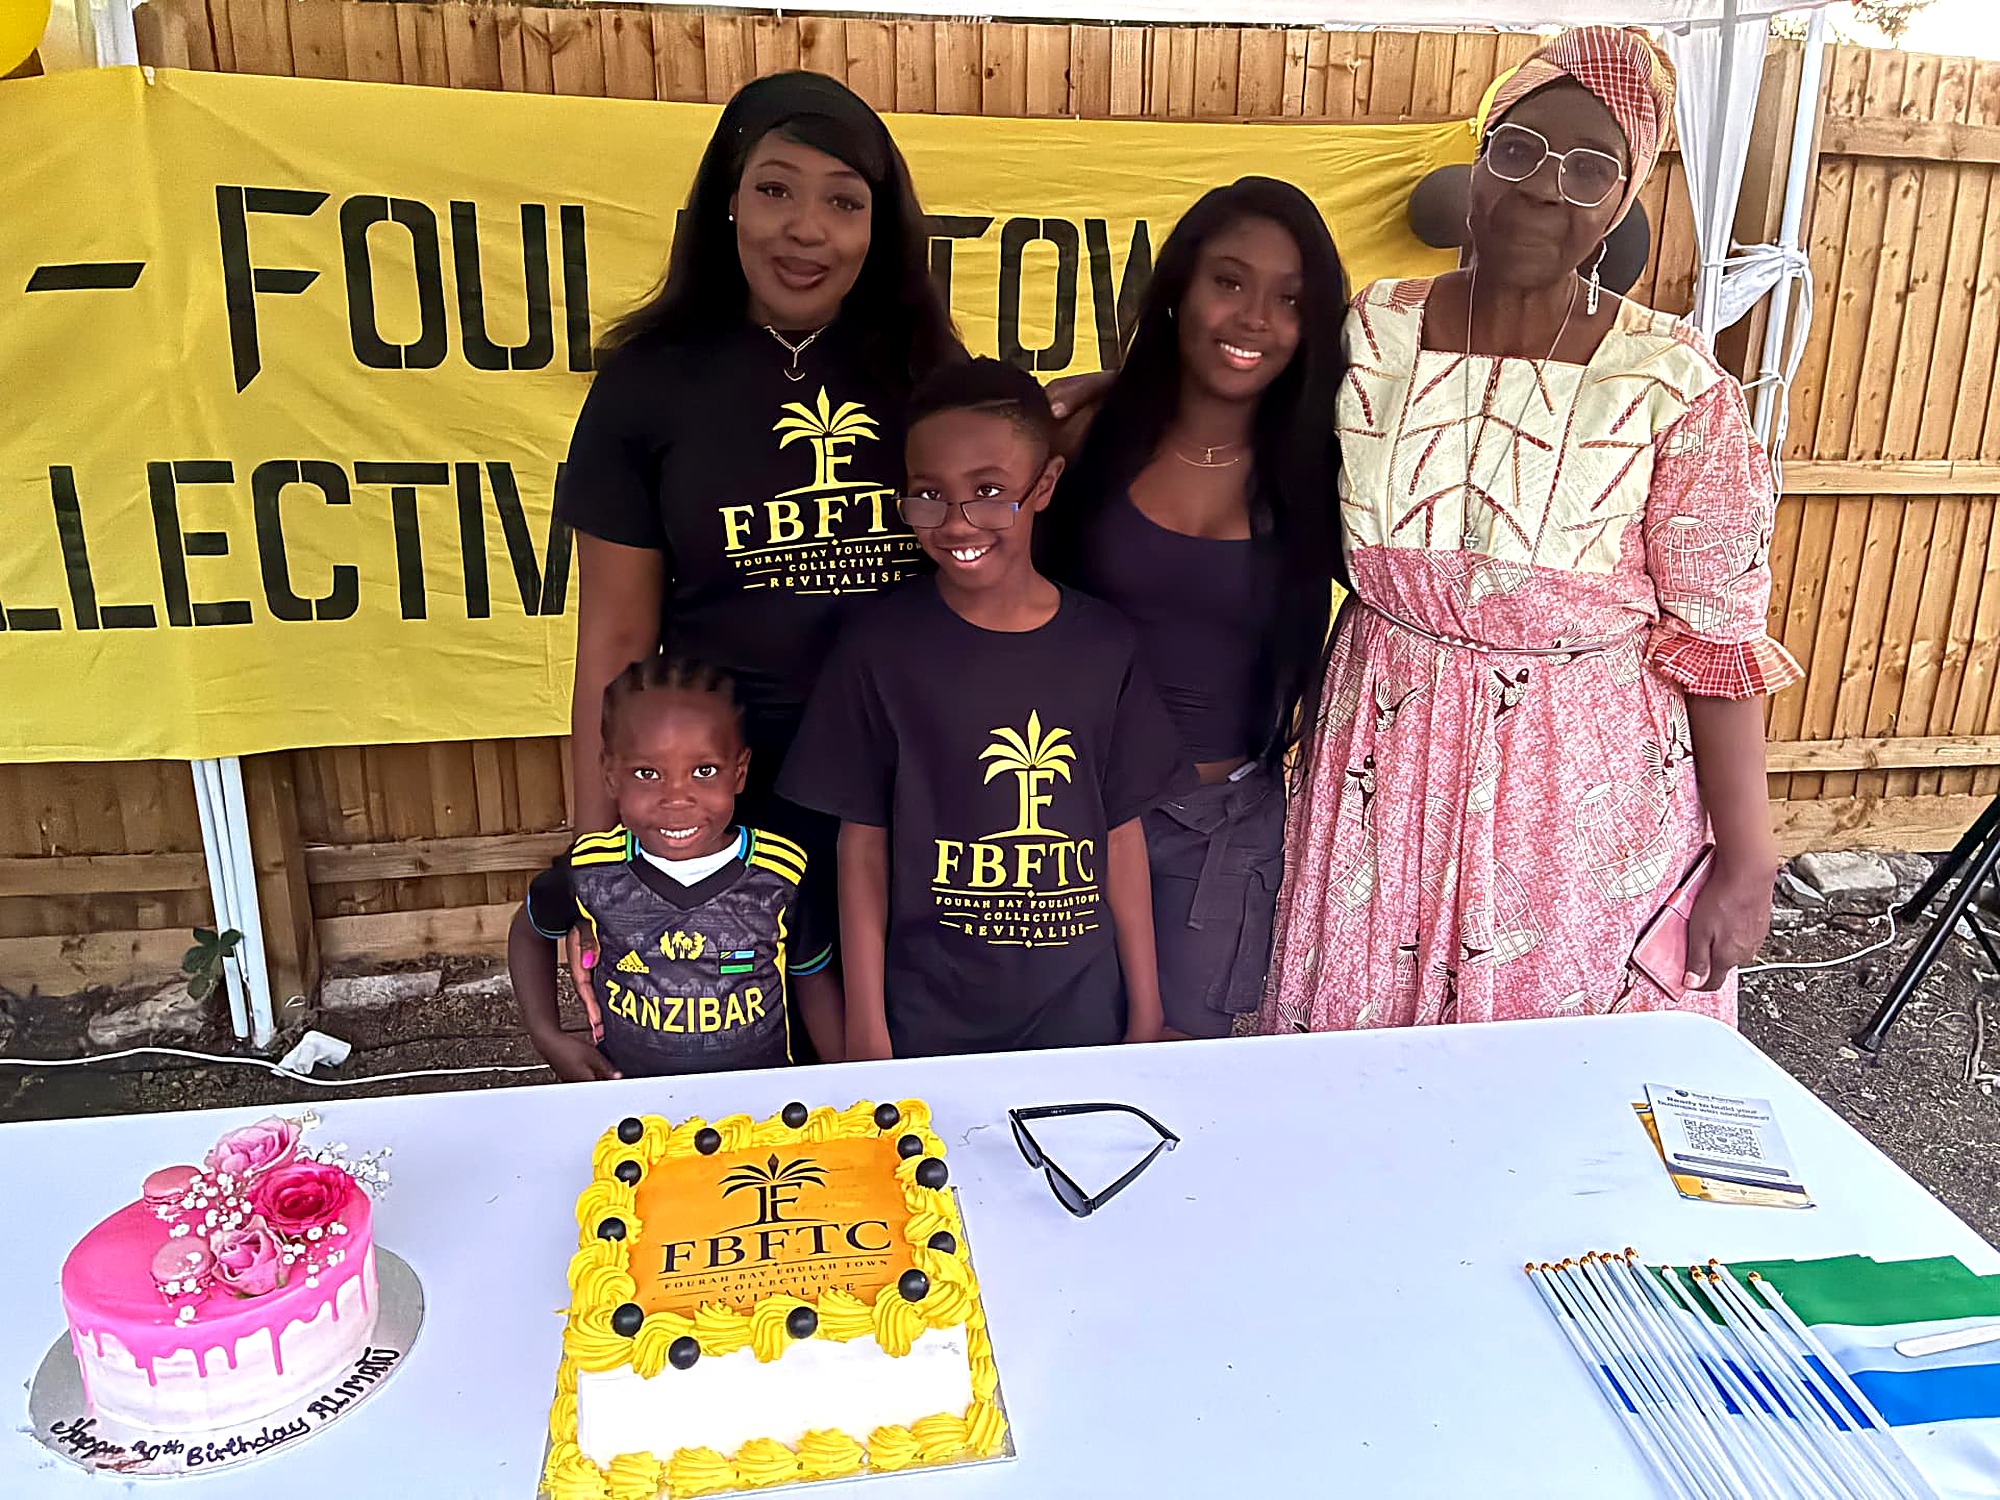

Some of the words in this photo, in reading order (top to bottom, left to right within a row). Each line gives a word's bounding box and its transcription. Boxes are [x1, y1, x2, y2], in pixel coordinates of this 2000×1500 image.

[215, 185, 612, 393] FOUL
[718, 488, 900, 551] FBFT
[734, 553, 793, 569] FOURAH
[801, 549, 827, 559] BAY
[836, 543, 892, 556] FOULAH
[788, 557, 884, 572] COLLECTIVE
[770, 570, 901, 588] REVITALISE
[932, 839, 1094, 888] FBFTC
[936, 896, 991, 909] FOURAH
[998, 899, 1023, 908] BAY
[984, 910, 1072, 923] COLLECTIVE
[964, 922, 1084, 939] REVITALISE
[605, 979, 766, 1033] ZANZIBAR
[658, 1221, 892, 1274] FBFTC
[665, 1275, 729, 1289] FOURAH
[739, 1270, 767, 1280] BAY
[777, 1263, 837, 1275] FOULAH
[846, 1260, 887, 1268] TOWN
[723, 1274, 830, 1292] COLLECTIVE
[187, 1417, 311, 1467] Birthday
